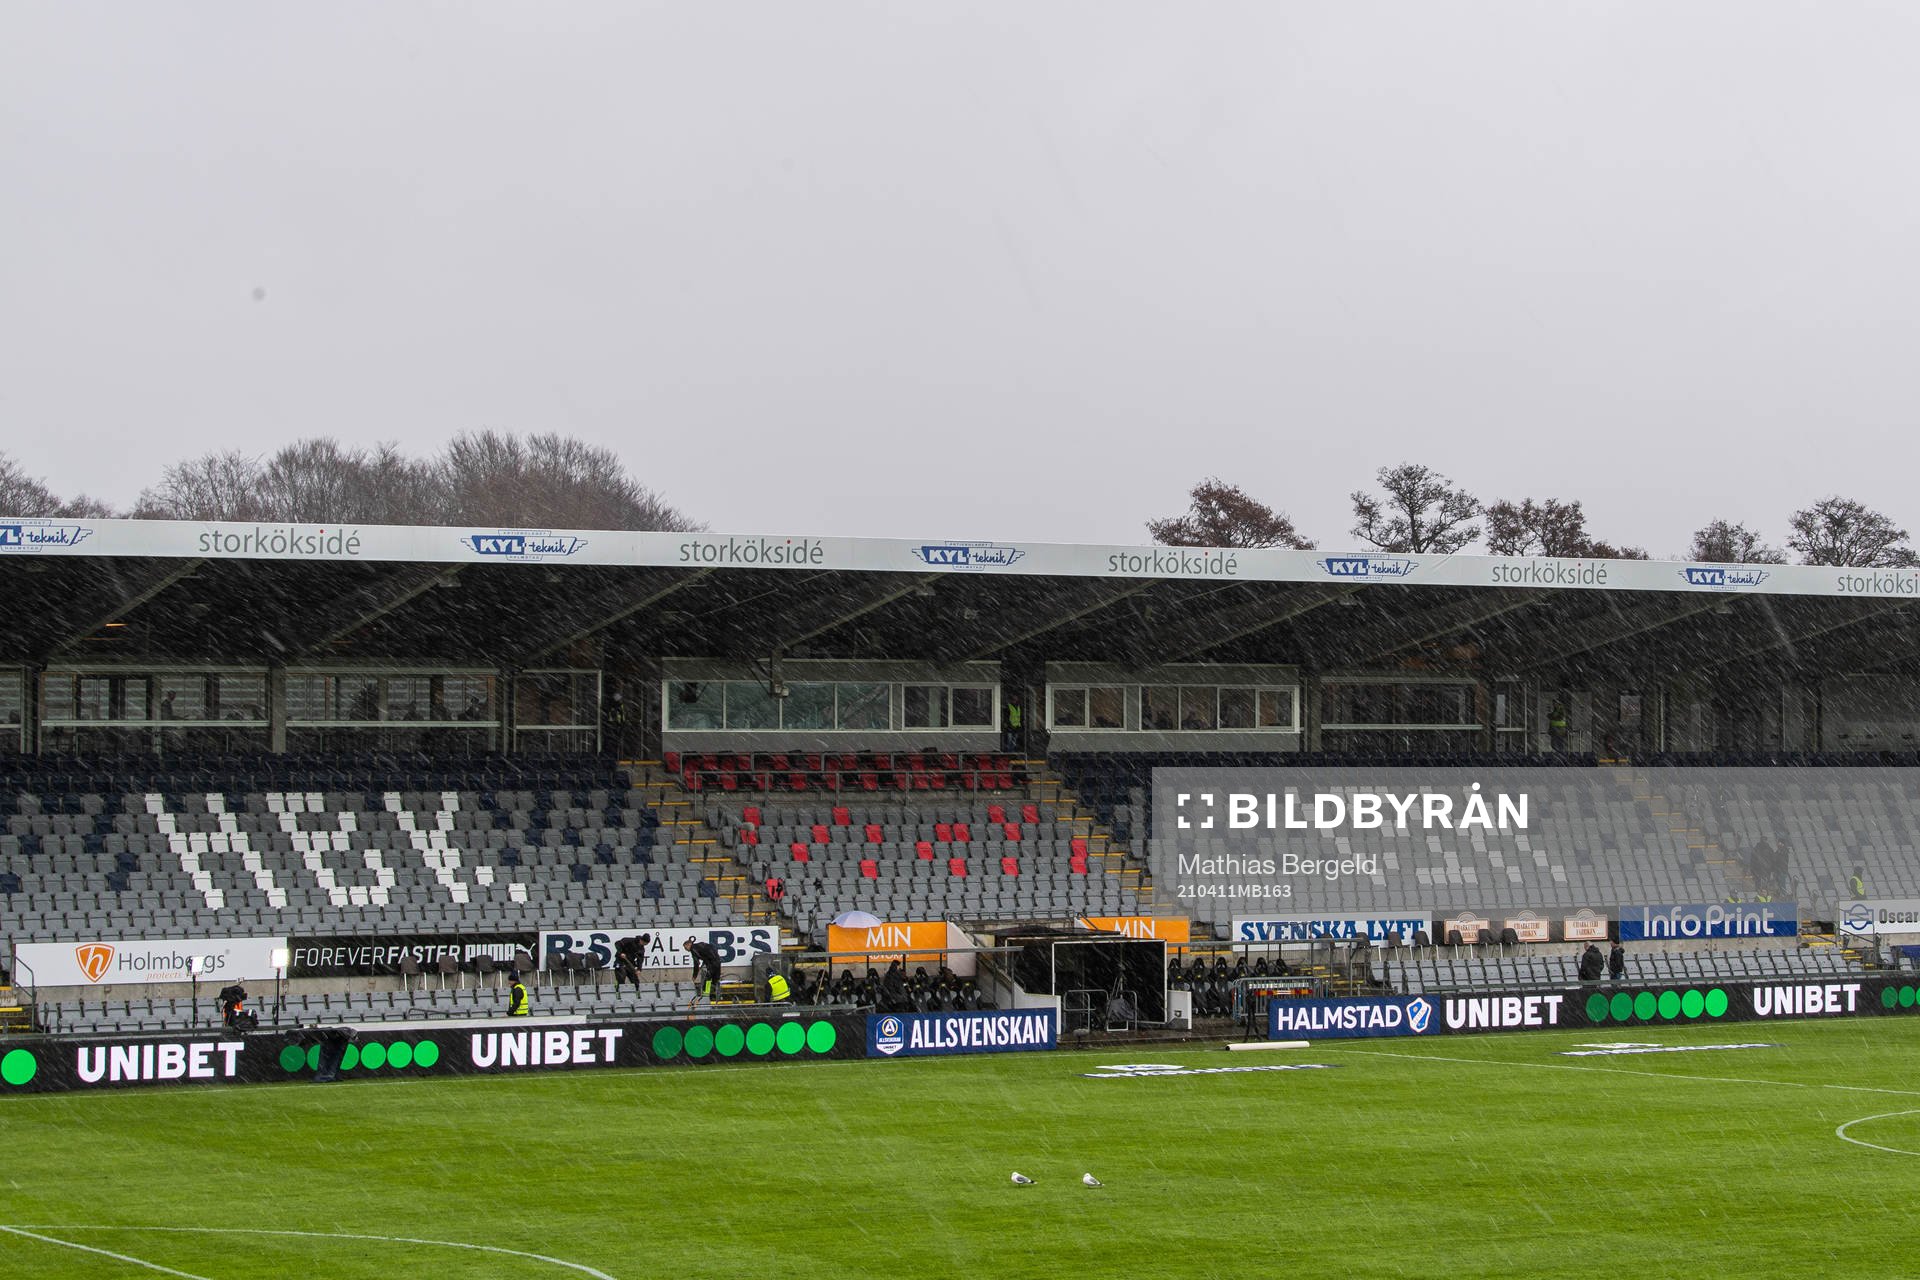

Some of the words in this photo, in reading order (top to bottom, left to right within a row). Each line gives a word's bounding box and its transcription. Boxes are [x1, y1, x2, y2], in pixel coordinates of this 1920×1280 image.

[26, 526, 69, 545] teknik
[199, 527, 361, 556] storköksidé
[528, 537, 567, 554] teknik
[679, 538, 824, 566] storköksidé
[972, 548, 1007, 565] teknik
[1108, 550, 1238, 577] storköksidé
[1372, 561, 1402, 577] teknik
[1492, 560, 1608, 585] storköksidé
[1727, 570, 1755, 586] teknik
[866, 926, 912, 948] MIN
[1114, 919, 1155, 939] MIN
[1240, 920, 1357, 941] SVENSKA
[1366, 919, 1424, 940] LYFT
[465, 943, 514, 962] PUMA
[1446, 995, 1563, 1029] UNIBET
[1754, 983, 1860, 1016] UNIBET
[1278, 1004, 1402, 1031] HALMSTAD
[910, 1014, 1048, 1049] ALLSVENSKAN
[471, 1029, 623, 1068] UNIBET
[77, 1042, 245, 1083] UNIBET
